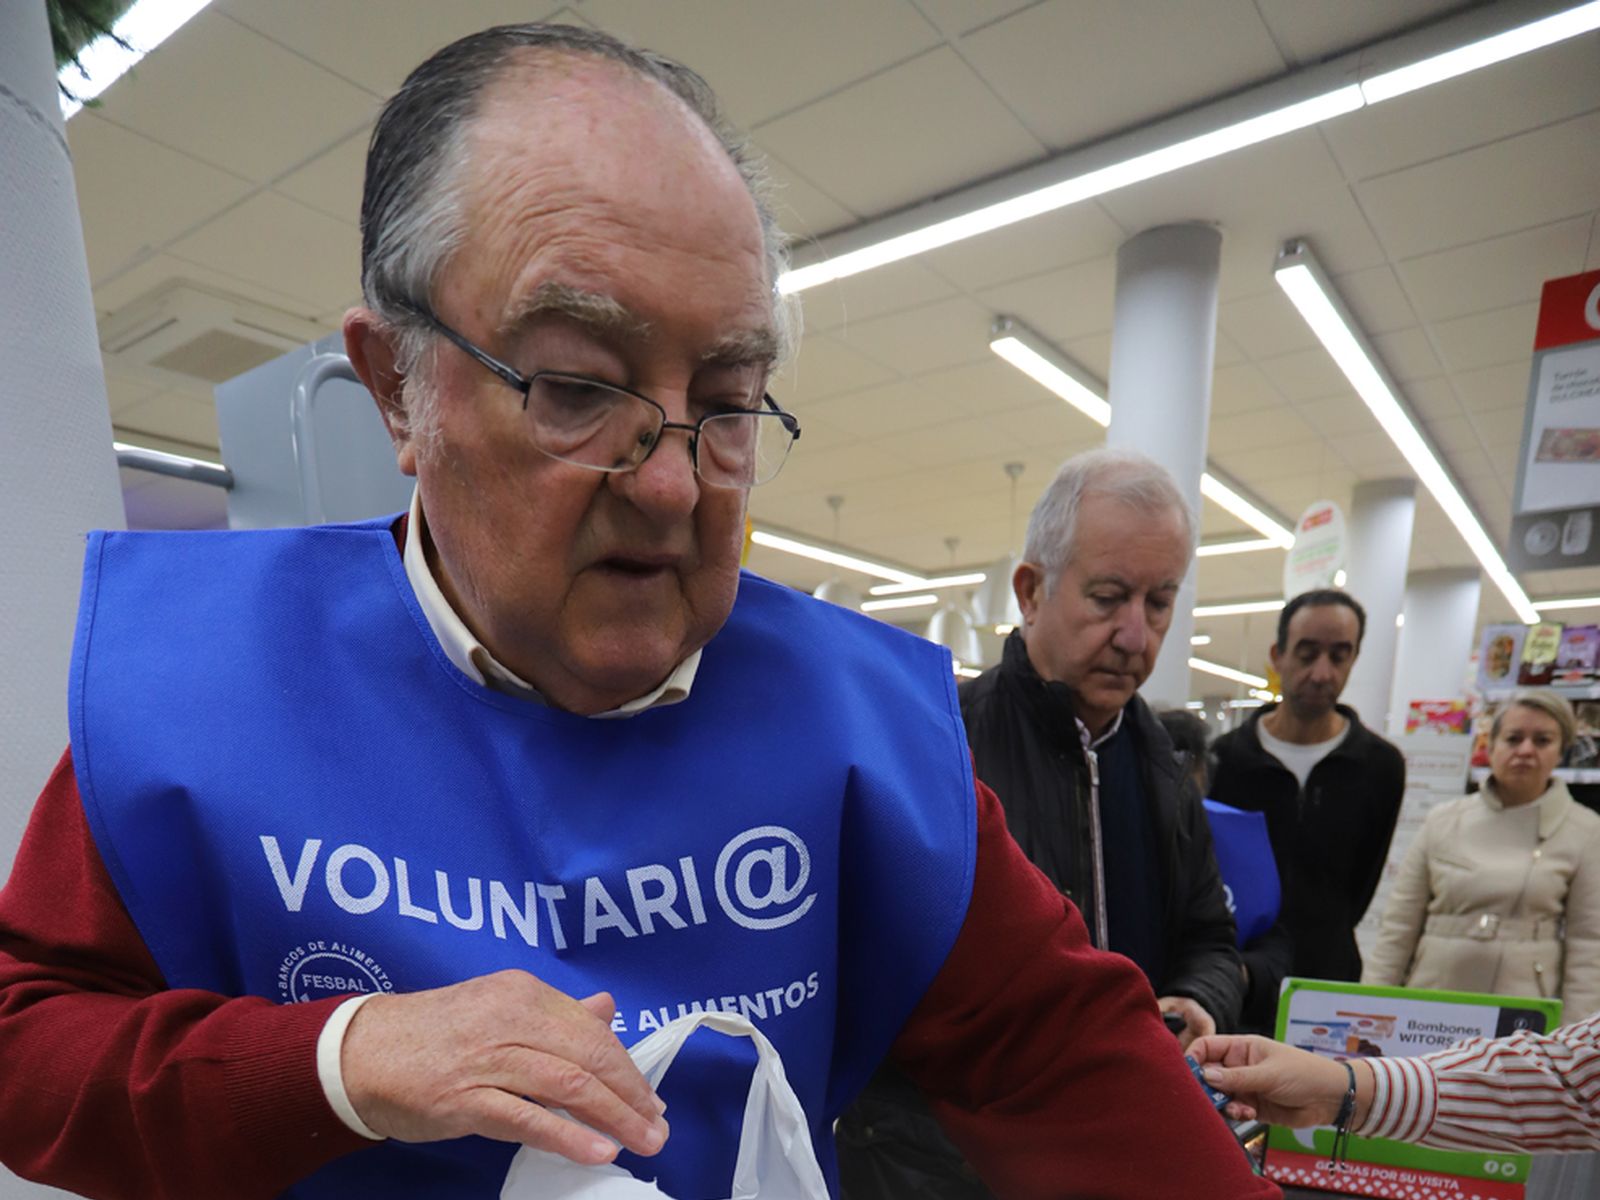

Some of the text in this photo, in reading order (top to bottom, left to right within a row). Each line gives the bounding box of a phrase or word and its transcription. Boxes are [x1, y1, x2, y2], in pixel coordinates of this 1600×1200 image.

[259, 825, 818, 950] VOLUNTARI@
[278, 941, 396, 995] BANCOS DE ALIMENTO
[302, 974, 370, 993] FESBAL
[1407, 1020, 1482, 1036] Bombones
[1371, 1168, 1398, 1182] POR
[1400, 1171, 1416, 1183] SU
[1418, 1174, 1460, 1190] VISITA
